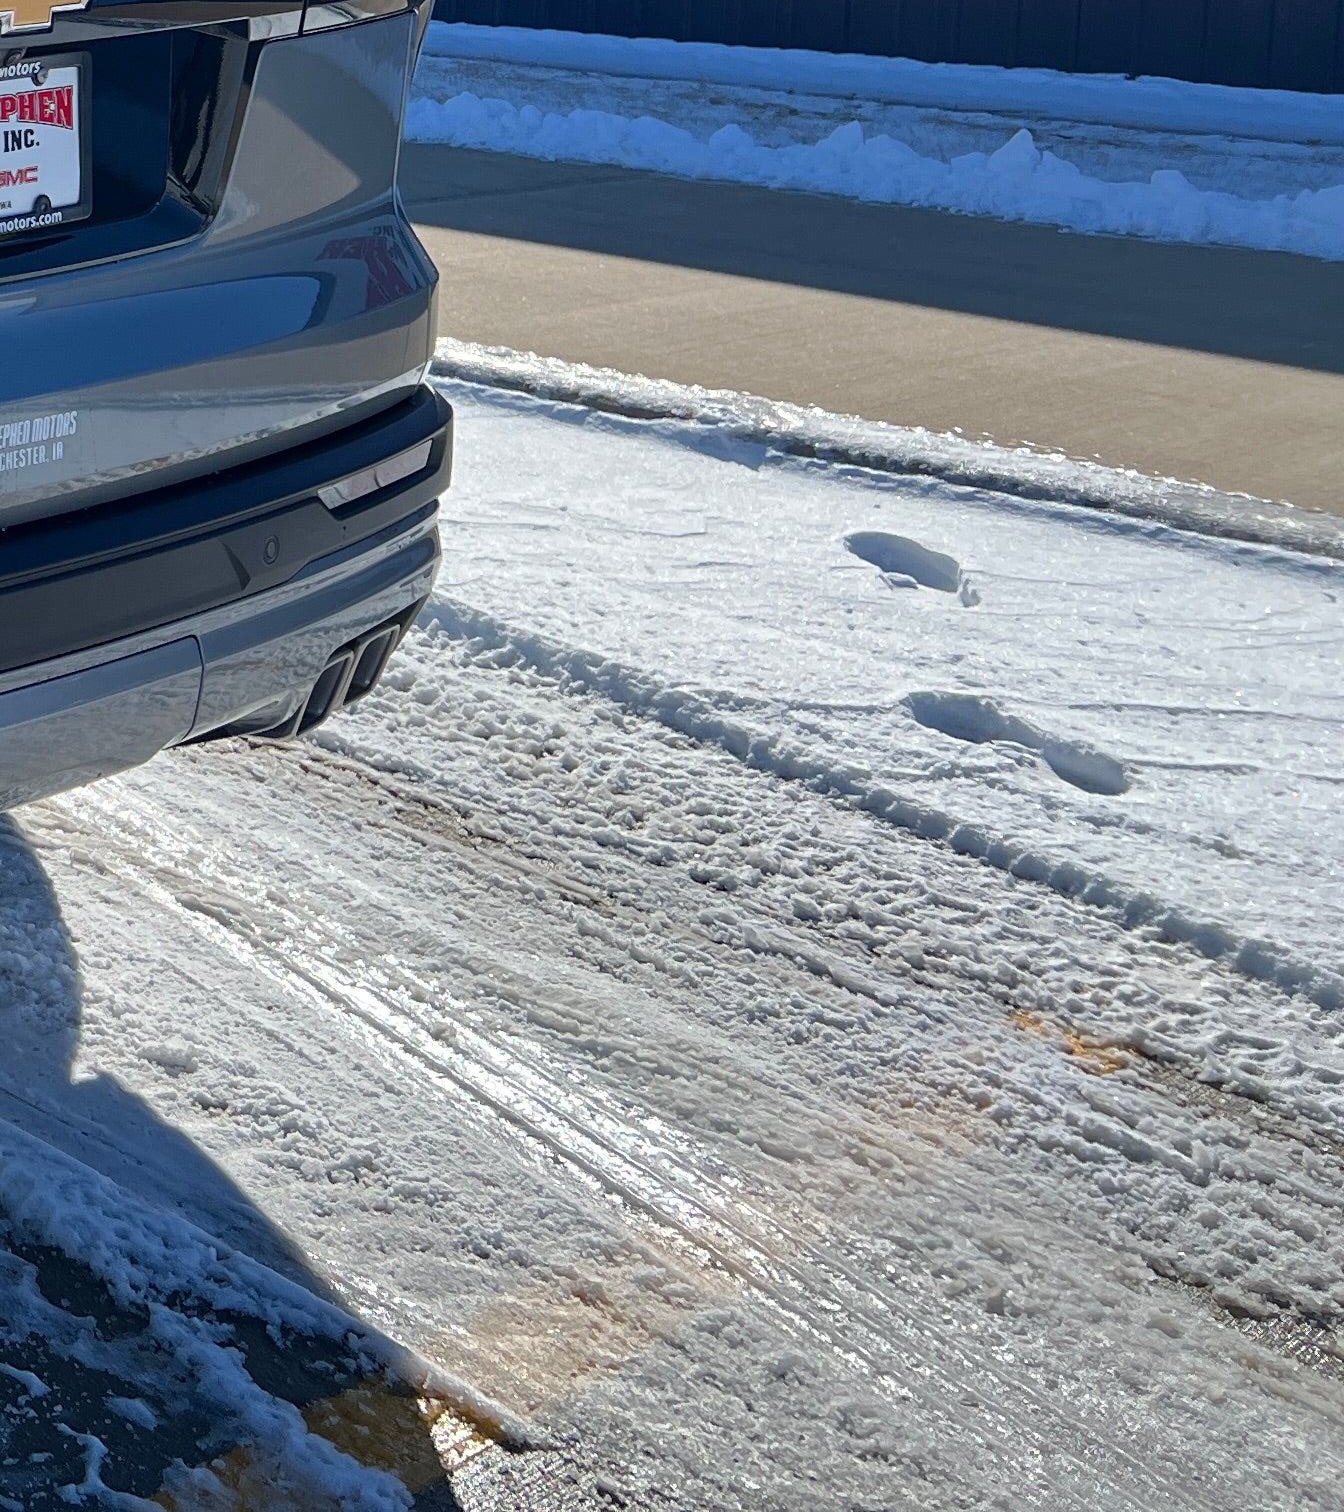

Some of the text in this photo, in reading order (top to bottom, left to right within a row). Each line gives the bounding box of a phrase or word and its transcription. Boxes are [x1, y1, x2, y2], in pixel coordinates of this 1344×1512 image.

[3, 129, 40, 153] INC.
[32, 410, 78, 442] MOTORS
[52, 441, 64, 461] IA
